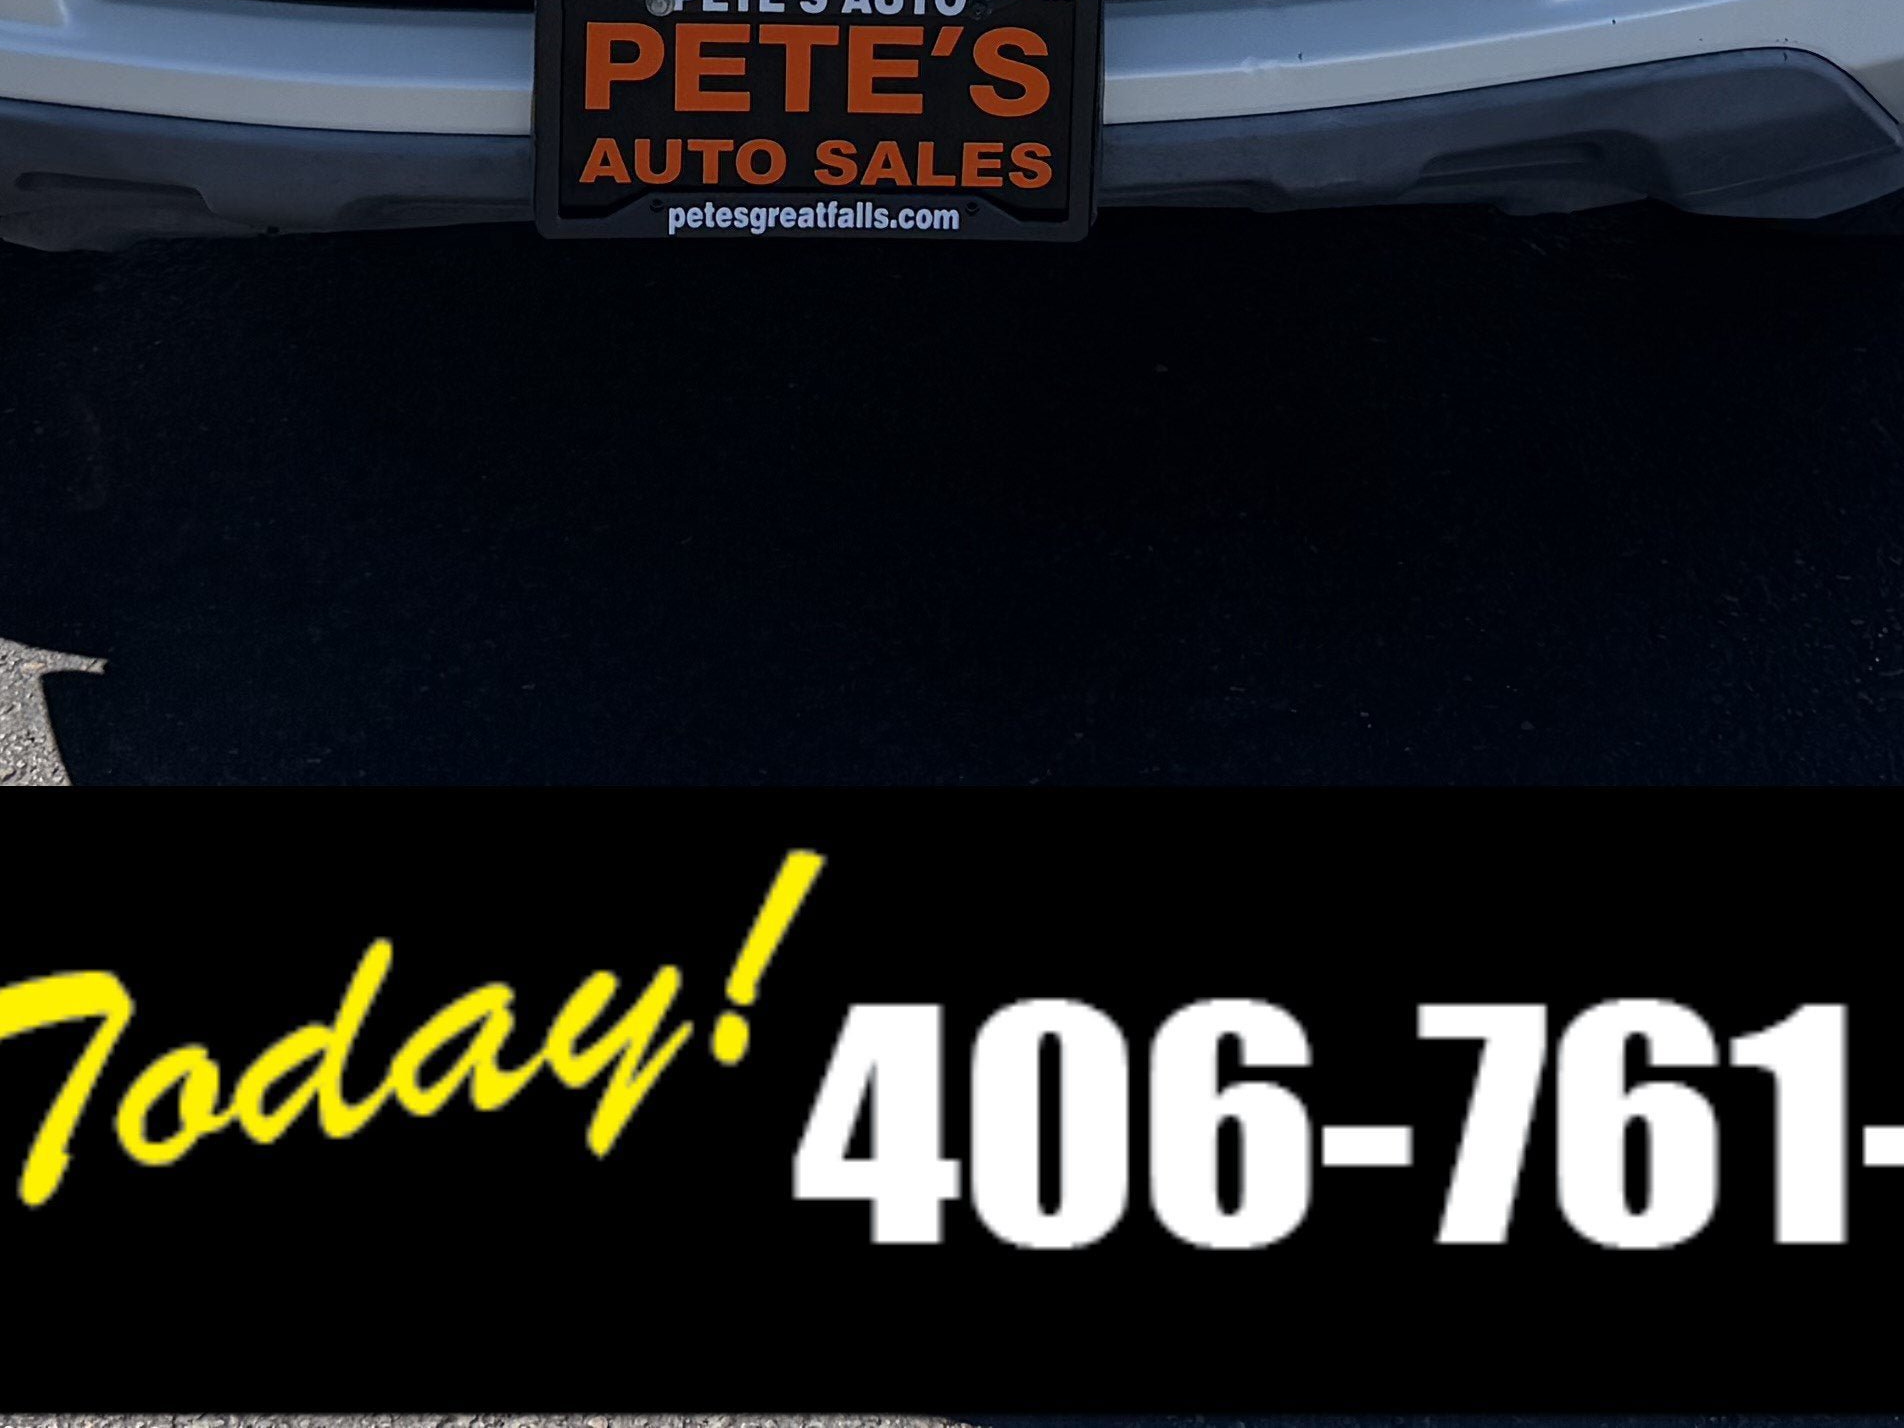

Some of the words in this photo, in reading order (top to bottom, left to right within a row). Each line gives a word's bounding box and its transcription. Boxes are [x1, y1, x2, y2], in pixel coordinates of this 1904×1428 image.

[584, 21, 1051, 118] PETE'S
[578, 138, 788, 184] AUTO
[813, 140, 1053, 189] SALES
[668, 200, 960, 235] petesgreatfalls.com
